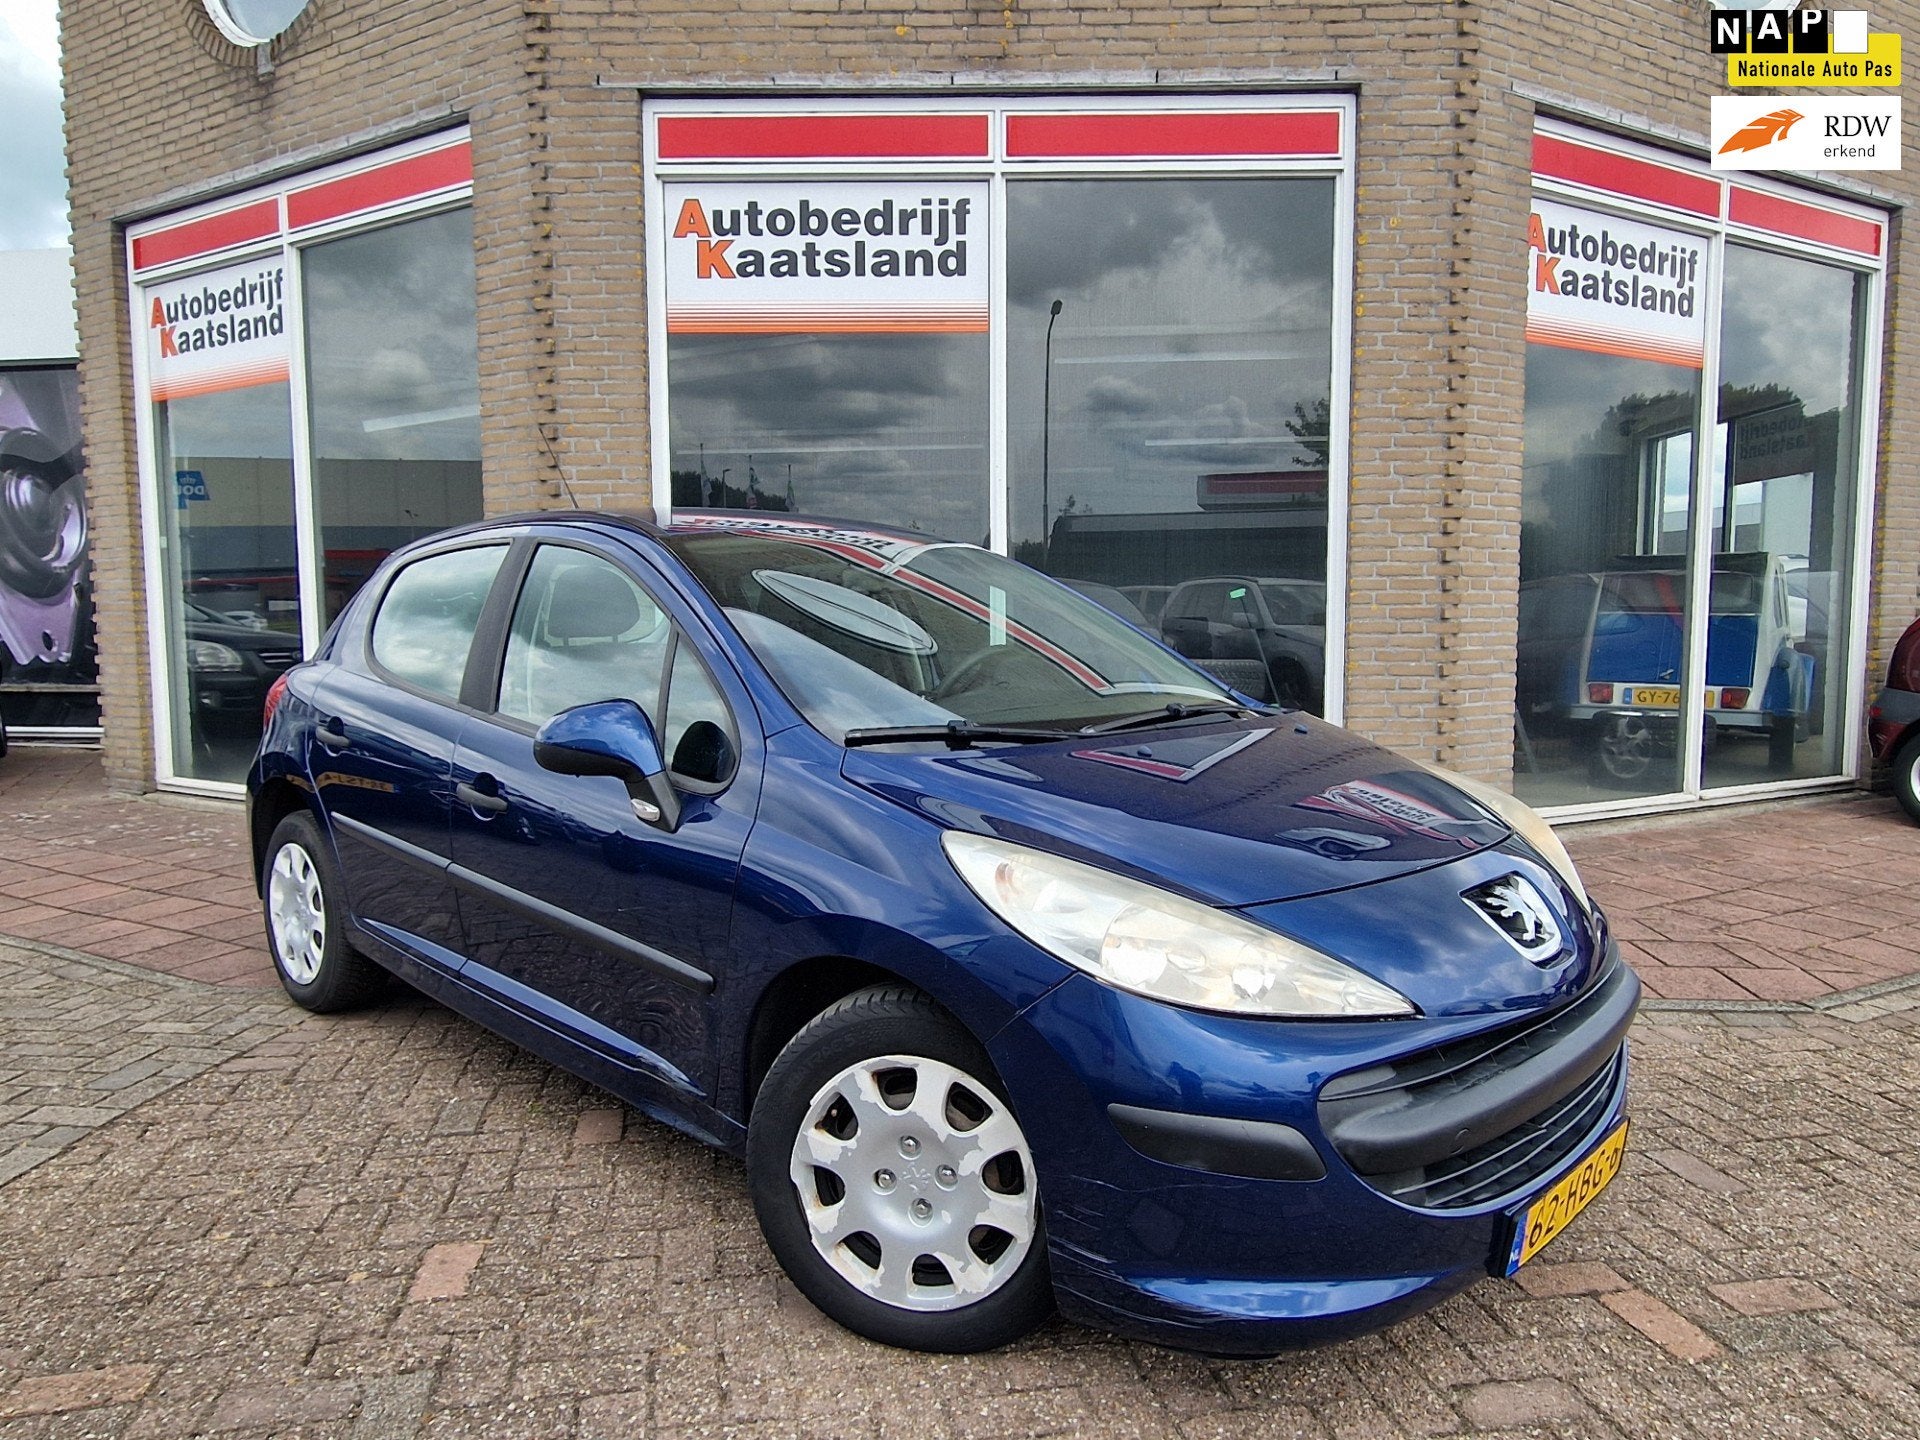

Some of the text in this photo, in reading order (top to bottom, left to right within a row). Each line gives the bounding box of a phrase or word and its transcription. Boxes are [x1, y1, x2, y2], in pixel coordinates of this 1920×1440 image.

[673, 198, 971, 246] Autobedrijf
[1527, 212, 1698, 288] Autobedrijf
[696, 240, 967, 279] Kaatsland
[1535, 254, 1694, 318] Kaatsland
[151, 268, 283, 329] Autobedrijf
[160, 303, 284, 359] Kaatsland
[1637, 690, 1680, 704] GY-76
